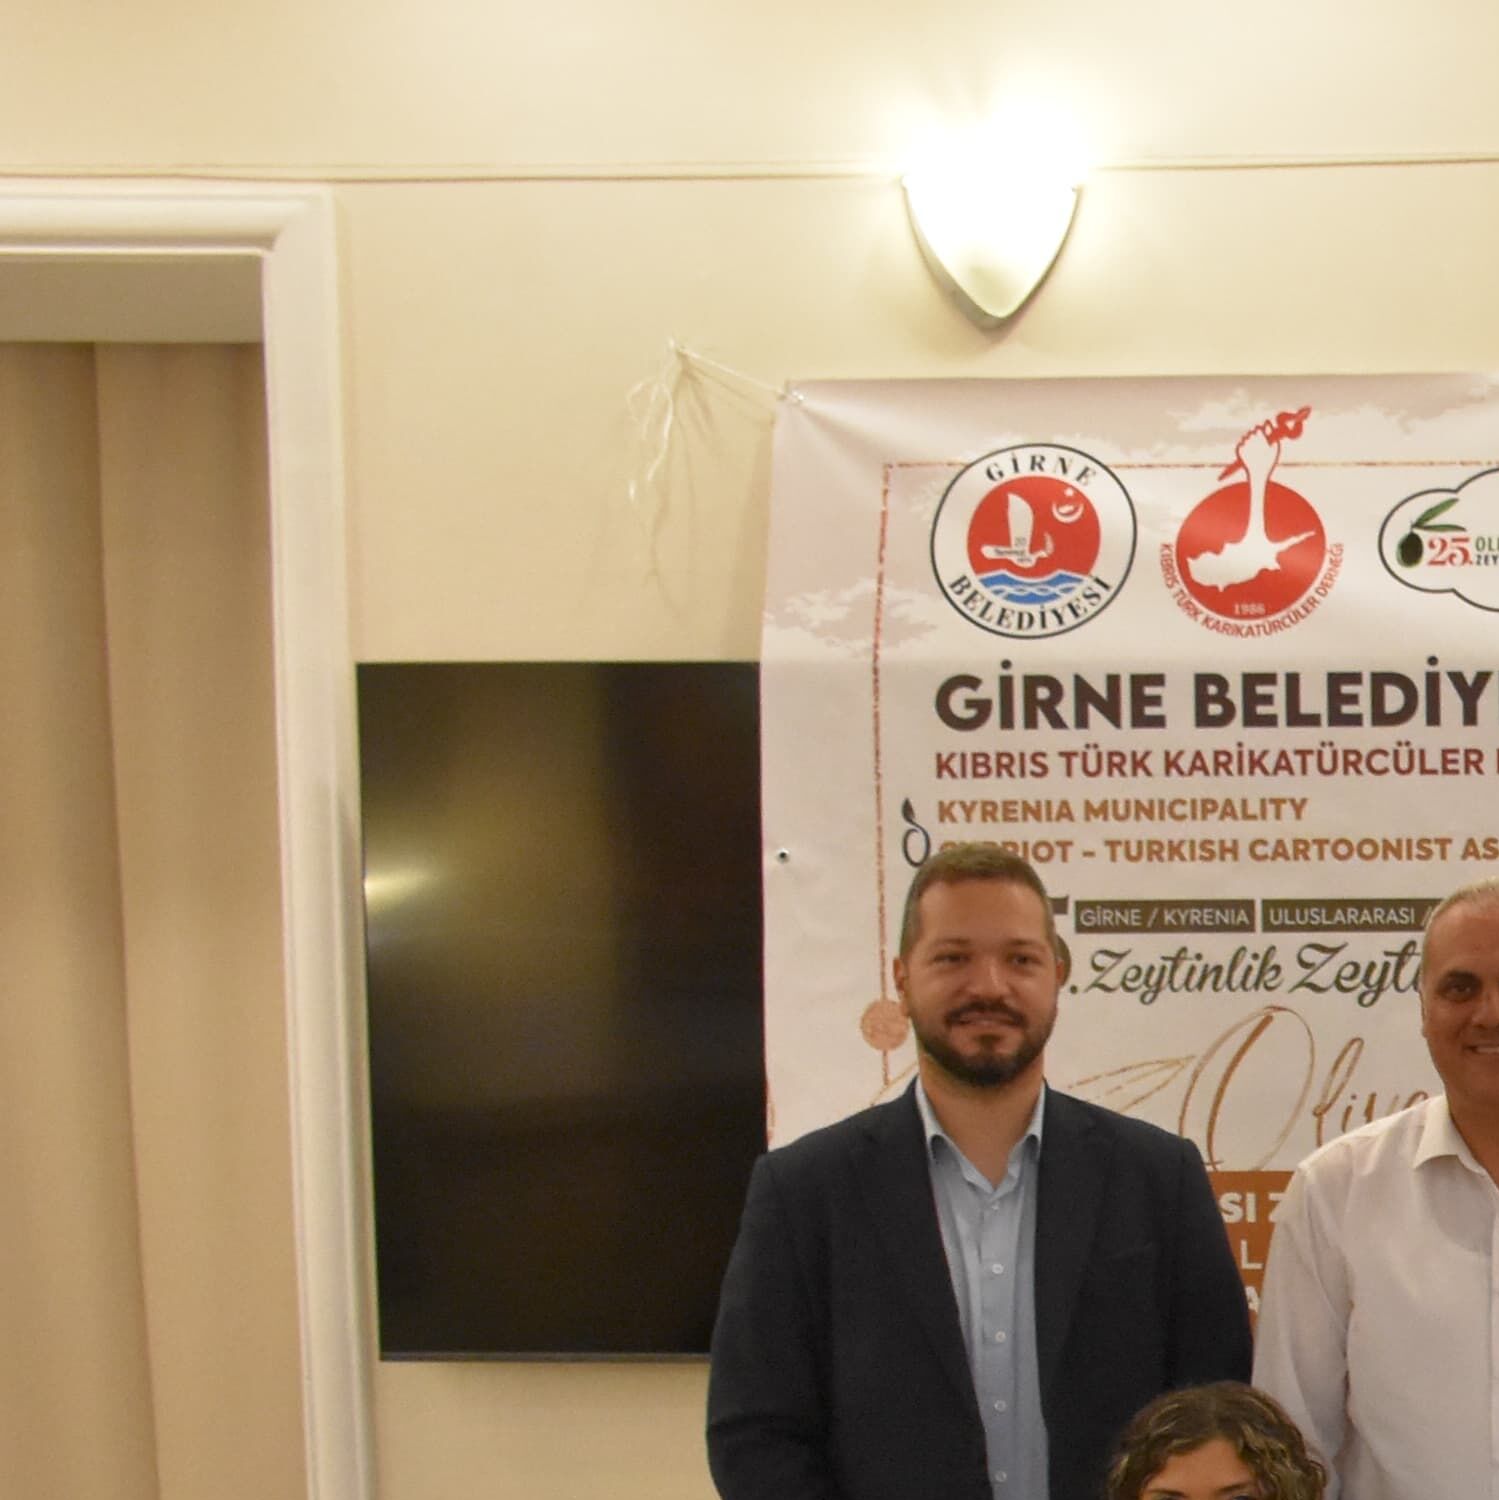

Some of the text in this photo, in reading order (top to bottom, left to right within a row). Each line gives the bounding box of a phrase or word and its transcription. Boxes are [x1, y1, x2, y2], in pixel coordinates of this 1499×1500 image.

[985, 453, 1098, 486] GİRNE
[949, 574, 1113, 632] BELEDİYESİ
[935, 659, 1167, 732] GİRNE
[935, 751, 1050, 779] KIBRIS
[1058, 743, 1153, 778] TÜRK
[1163, 741, 1485, 778] KARİKATÜRCÜLER
[938, 798, 1308, 823] KYRENIA MUNICIPALITY
[1104, 840, 1240, 863] TURKISH
[1248, 837, 1453, 863] CARTOONIST
[1080, 905, 1142, 928] GİRNE
[1164, 907, 1250, 927] KYRENIA
[1269, 907, 1416, 927] ULUSLARARASI
[1085, 944, 1285, 1006] Zeytinlik
